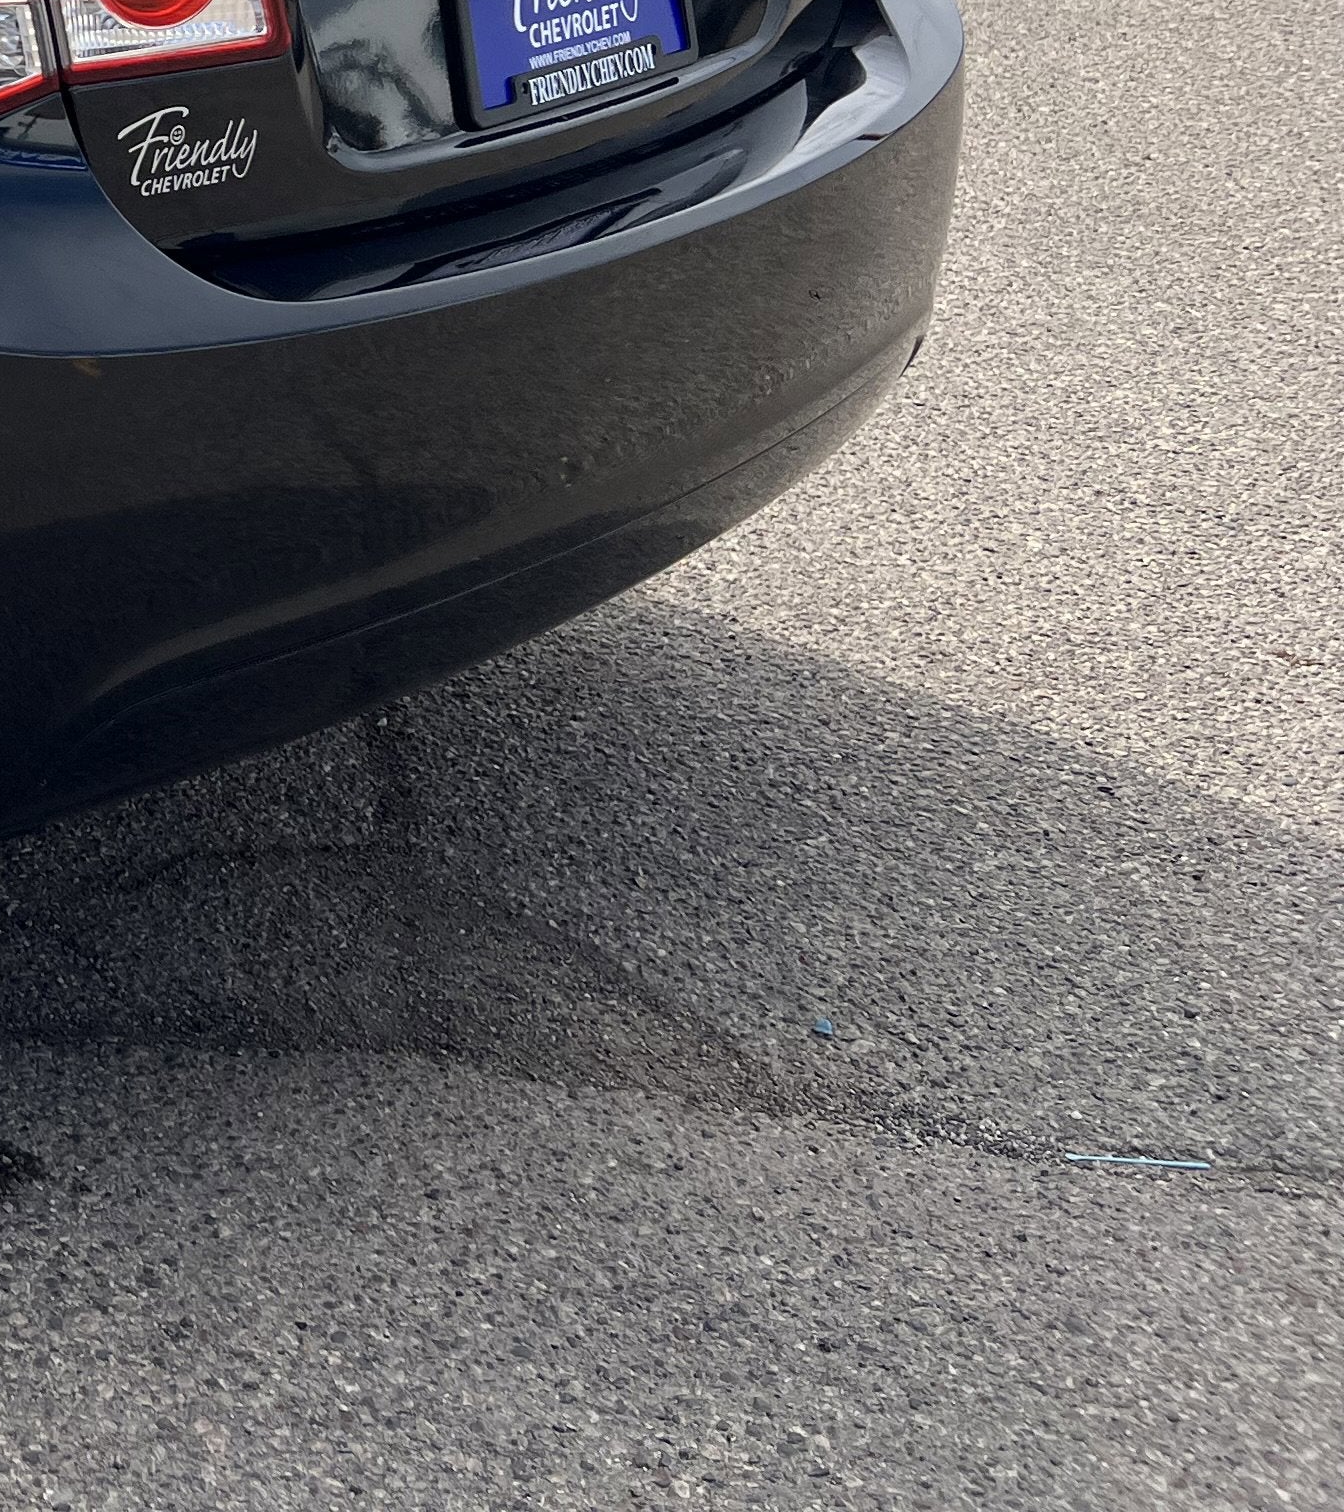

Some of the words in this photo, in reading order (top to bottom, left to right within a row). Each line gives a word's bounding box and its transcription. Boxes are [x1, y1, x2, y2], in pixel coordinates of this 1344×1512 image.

[529, 3, 619, 49] CHEVROLET
[528, 30, 632, 70] WWW.FRIENDLYCHEV.COM
[527, 43, 656, 106] FRIENDLYCHEV.COM
[117, 105, 258, 187] Friendly
[140, 164, 231, 197] CHEVROLET
